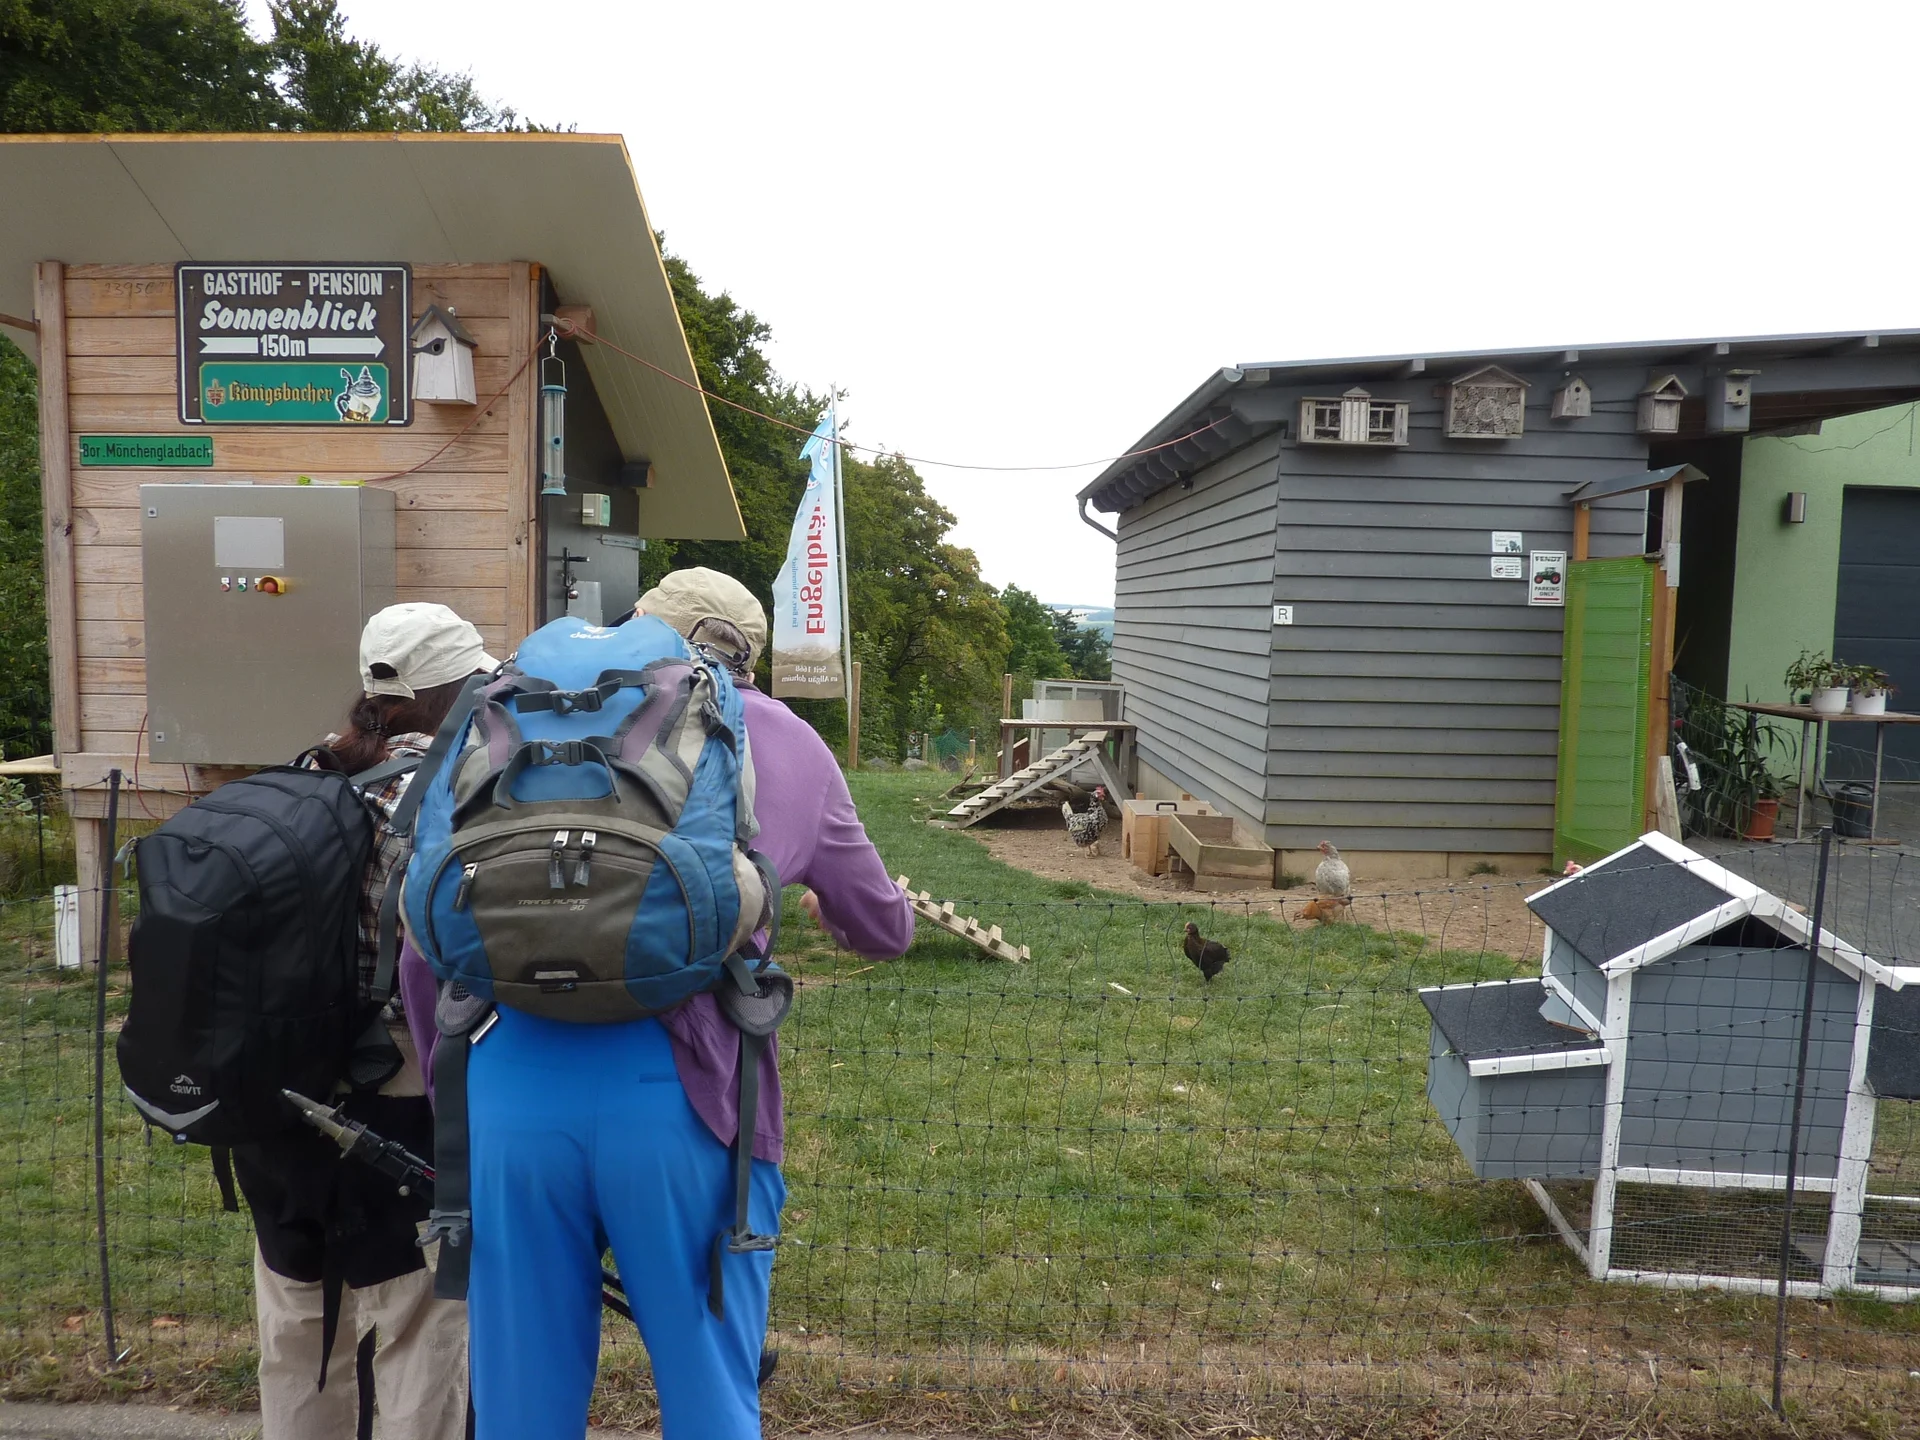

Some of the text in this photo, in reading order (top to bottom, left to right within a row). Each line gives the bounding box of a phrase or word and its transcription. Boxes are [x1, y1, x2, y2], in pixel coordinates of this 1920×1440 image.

[203, 272, 283, 296] GASTHOF
[308, 272, 383, 296] PENSION
[200, 299, 377, 331] Sonnenblick
[260, 334, 306, 357] 150m
[228, 380, 334, 406] Königsbacher
[106, 442, 211, 462] Mönchengladbach
[1278, 608, 1288, 620] R
[169, 1083, 202, 1096] CRIVIT
